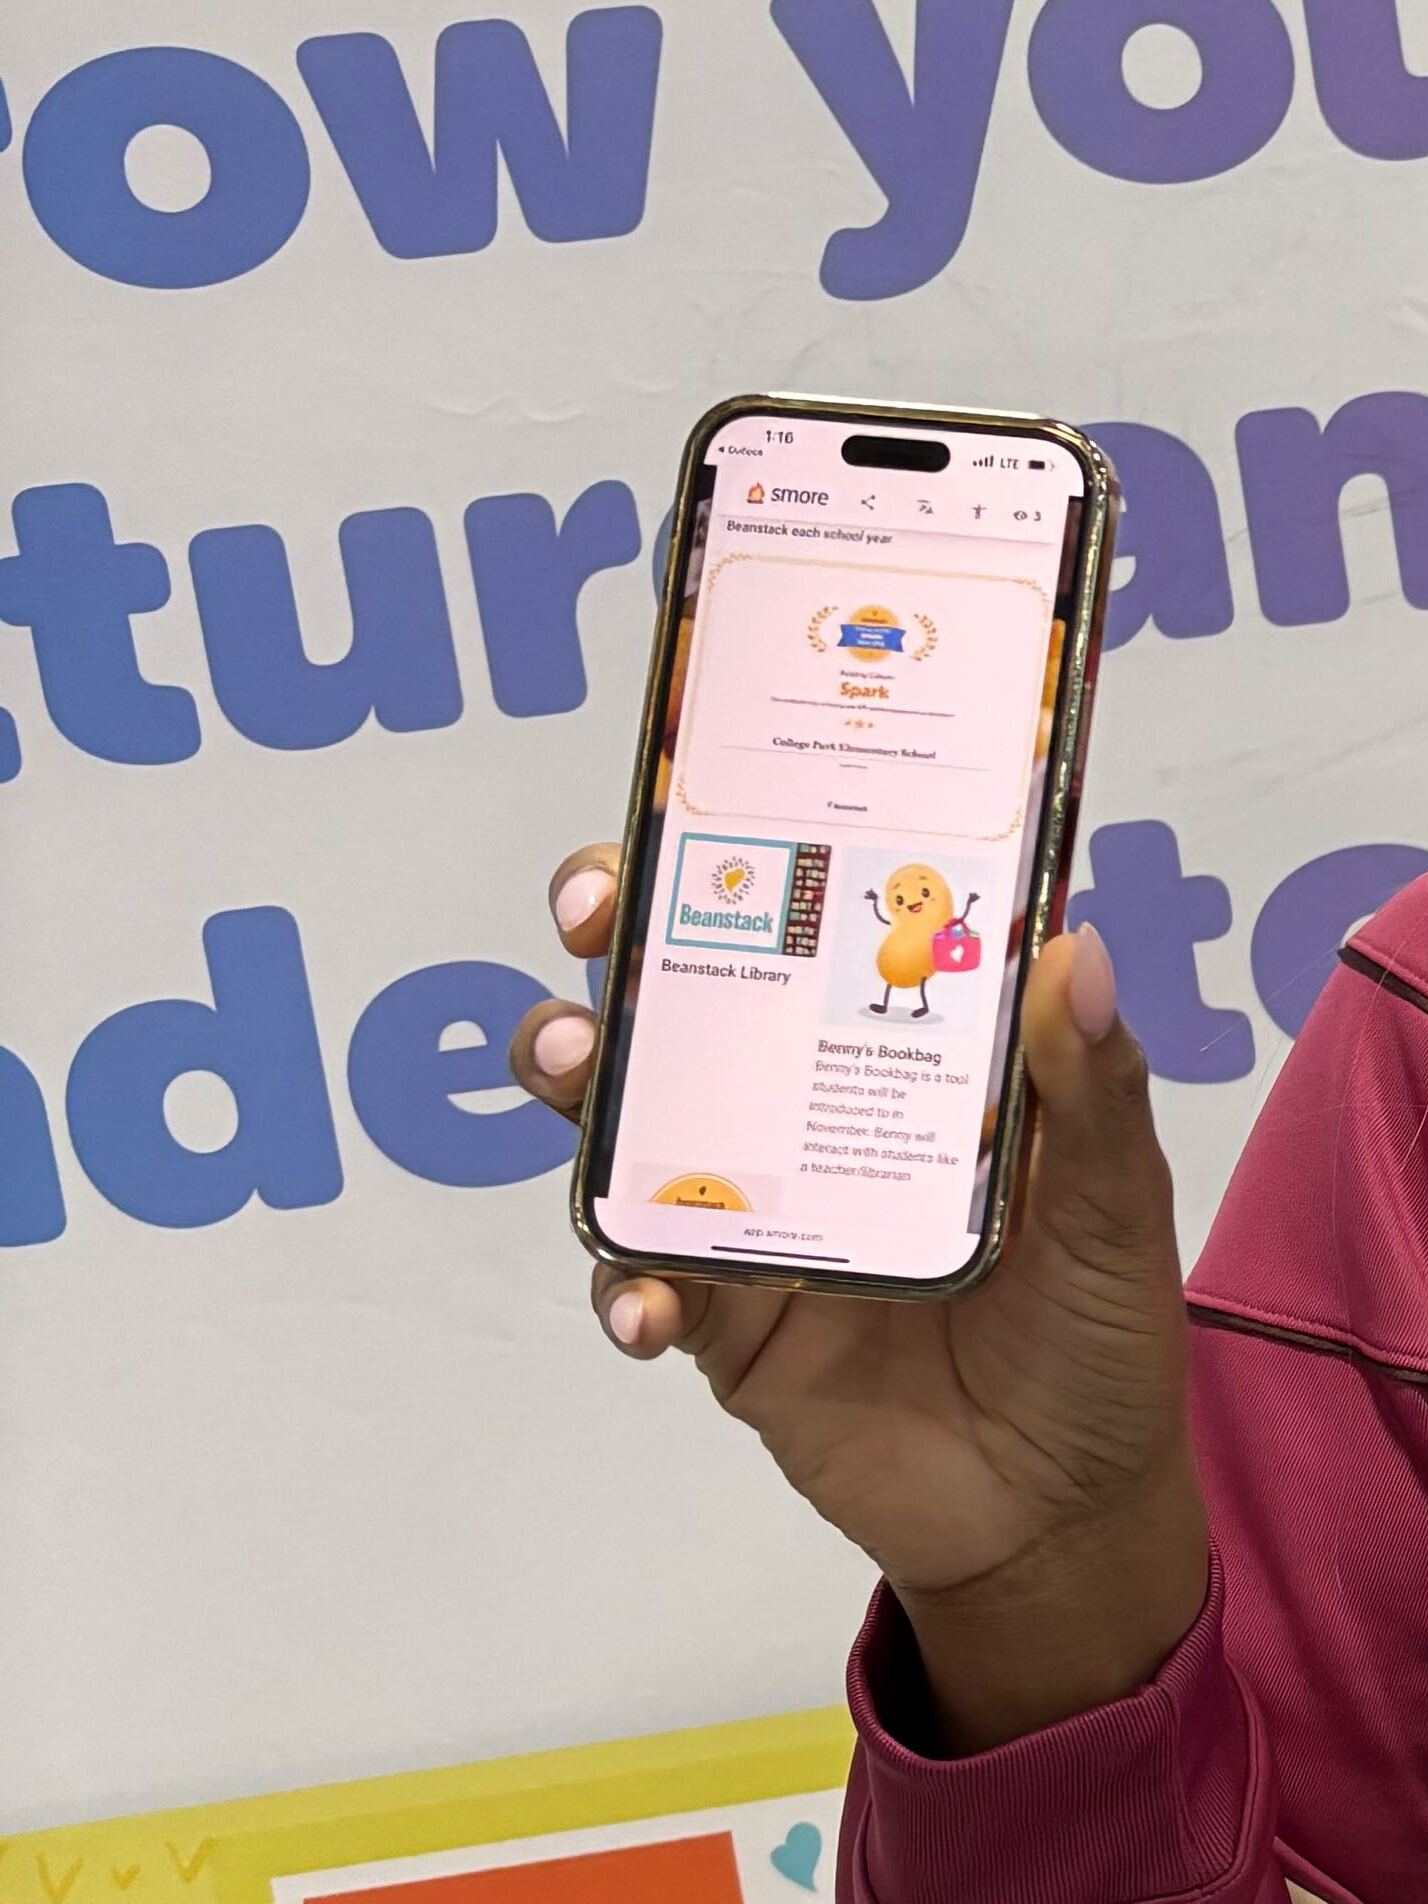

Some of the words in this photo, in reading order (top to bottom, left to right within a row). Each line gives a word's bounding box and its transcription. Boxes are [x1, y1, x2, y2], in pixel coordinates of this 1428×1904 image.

[0, 4, 663, 291] ow
[999, 457, 1019, 470] LTE
[770, 486, 829, 507] smore
[726, 519, 789, 536] Beanstack
[791, 526, 820, 539] each
[823, 529, 864, 544] school
[865, 532, 893, 545] year
[840, 681, 889, 700] Spark
[678, 902, 774, 934] Beanstack
[660, 958, 737, 979] Beanstack
[740, 965, 792, 986] Library
[817, 1039, 874, 1059] Benny's
[877, 1045, 942, 1066] Bookbag
[863, 1064, 918, 1083] Bookbag
